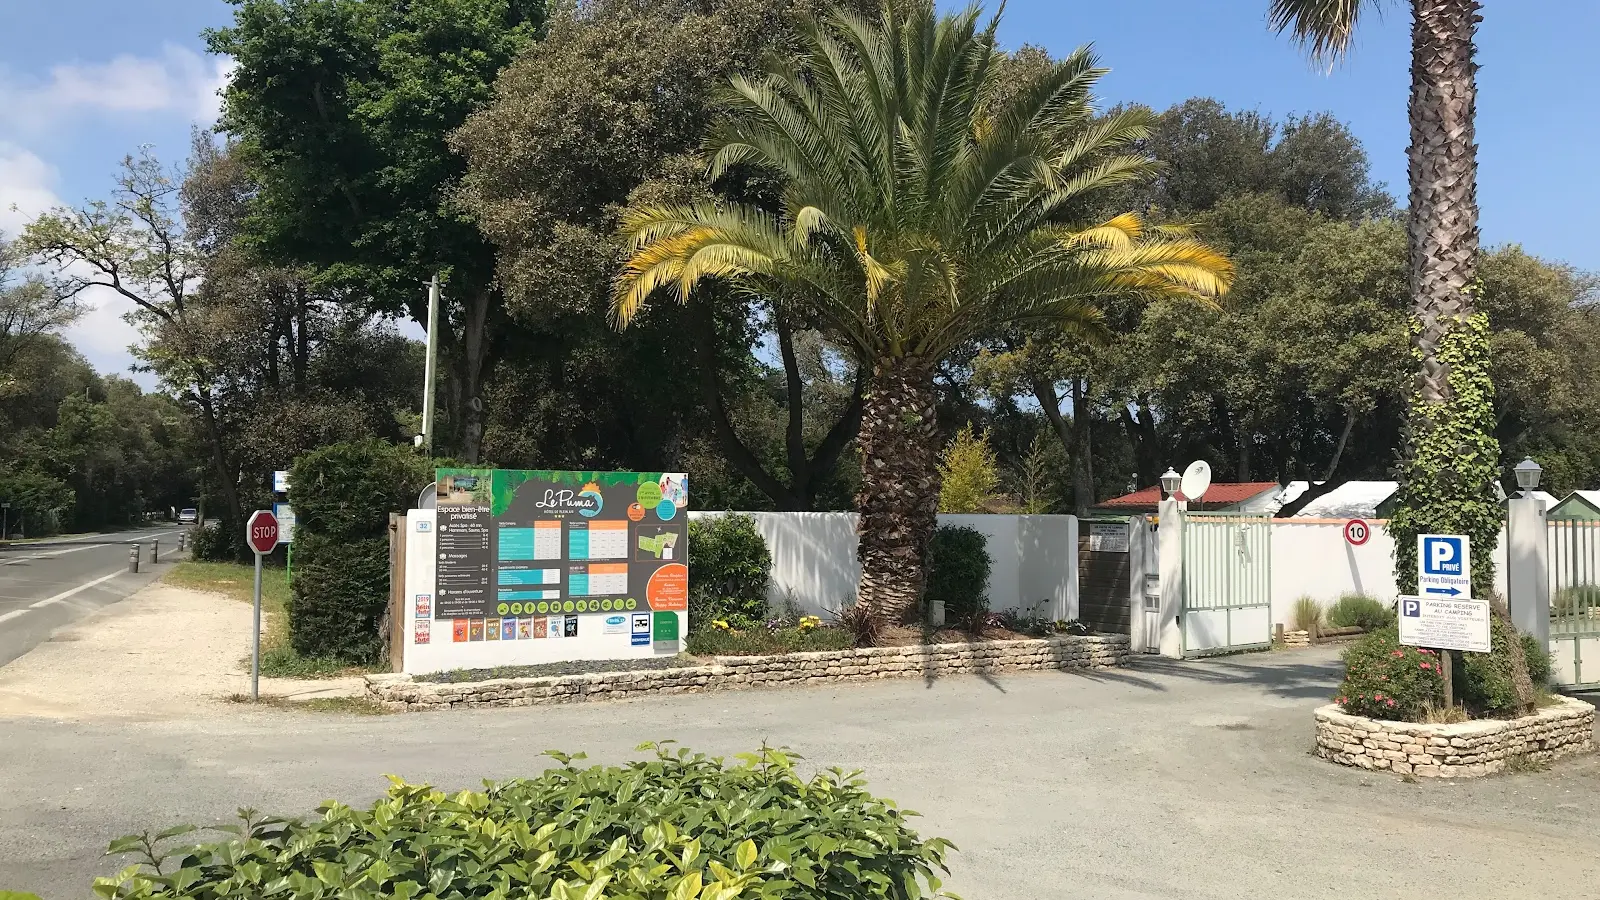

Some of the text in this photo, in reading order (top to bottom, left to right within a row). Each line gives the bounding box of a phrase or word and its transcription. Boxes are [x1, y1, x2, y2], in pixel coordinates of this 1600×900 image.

[536, 488, 594, 508] Le Puma
[438, 506, 460, 514] Espace
[451, 512, 477, 520] privatisé
[254, 526, 276, 539] STOP
[1350, 527, 1364, 538] 10
[1431, 541, 1454, 570] P
[1442, 563, 1460, 571] PRIVÉ
[1420, 576, 1469, 585] Parking Obligatoire
[1406, 602, 1417, 615] P
